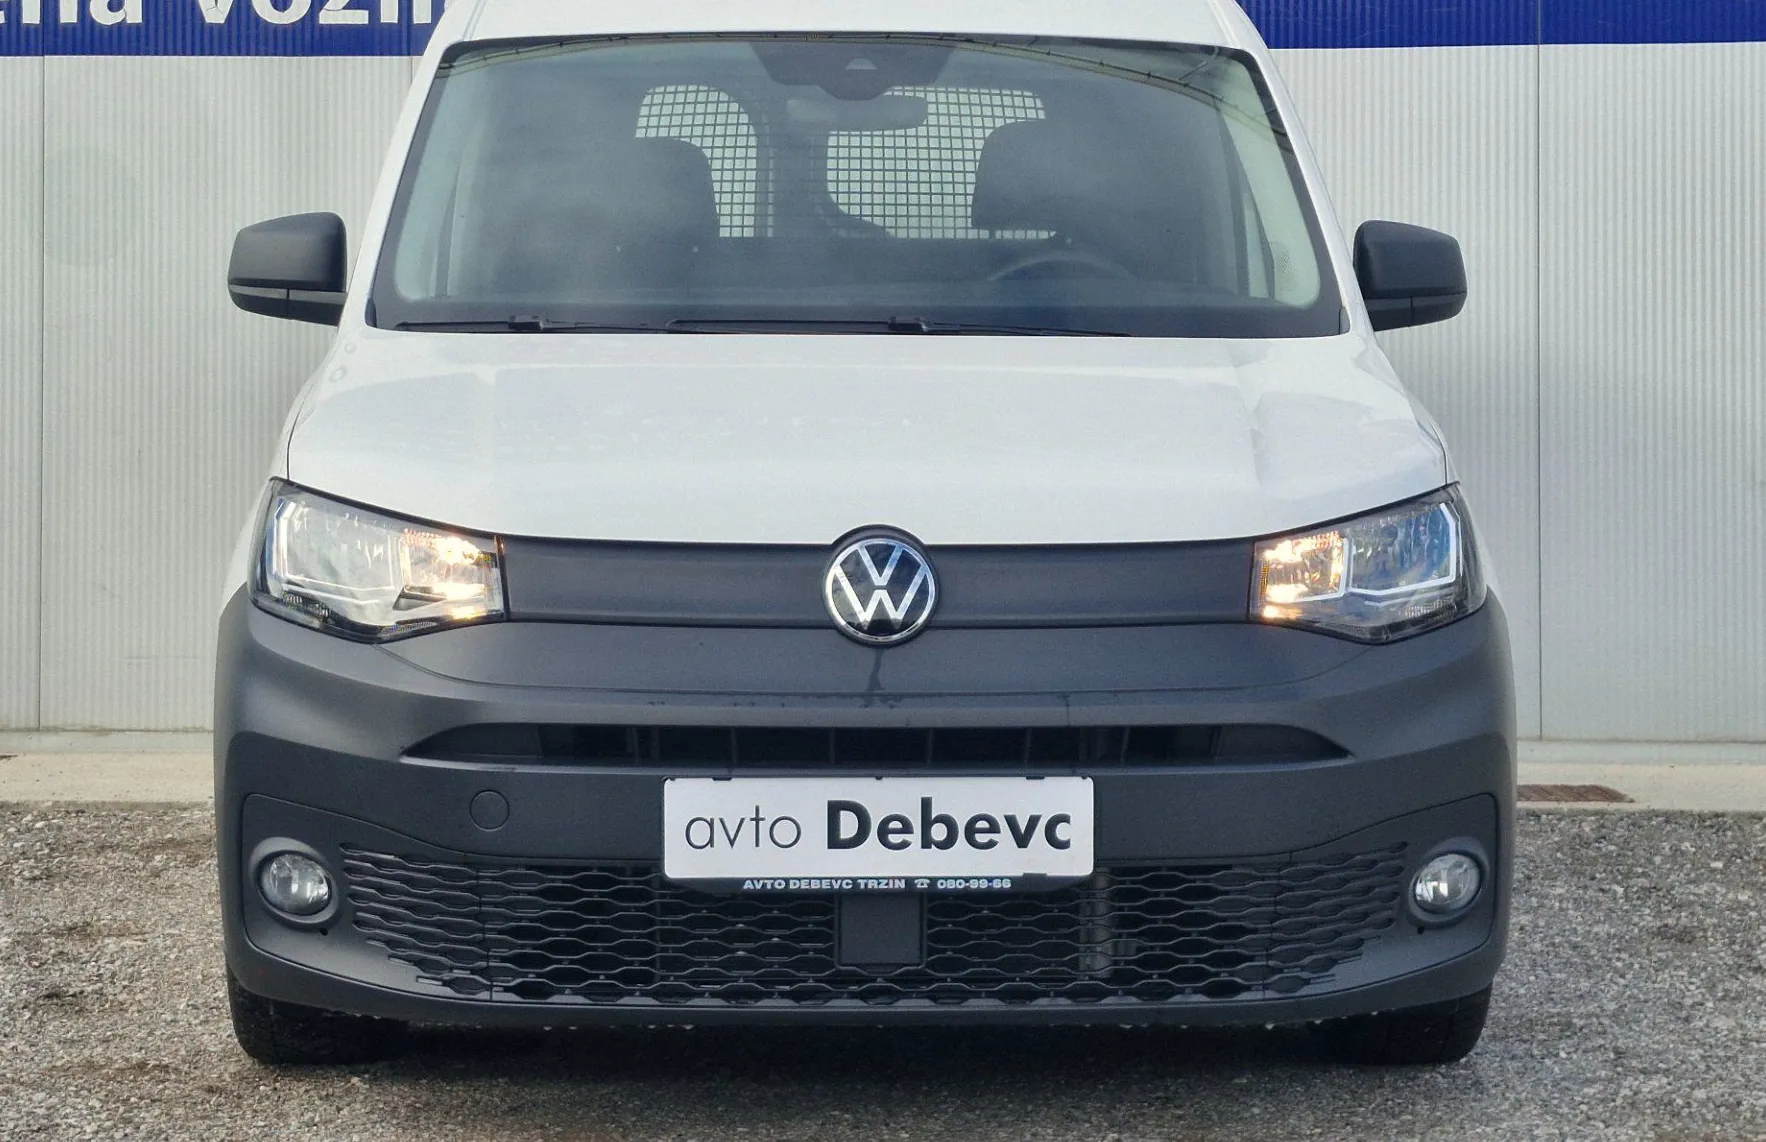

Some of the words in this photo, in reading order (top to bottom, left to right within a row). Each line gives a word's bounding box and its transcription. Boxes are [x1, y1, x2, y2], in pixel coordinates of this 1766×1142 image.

[685, 805, 802, 849] avto
[826, 796, 1072, 850] Debevc
[743, 879, 786, 889] AVTO
[789, 879, 853, 889] DEBEVC
[857, 879, 905, 889] TRZIN
